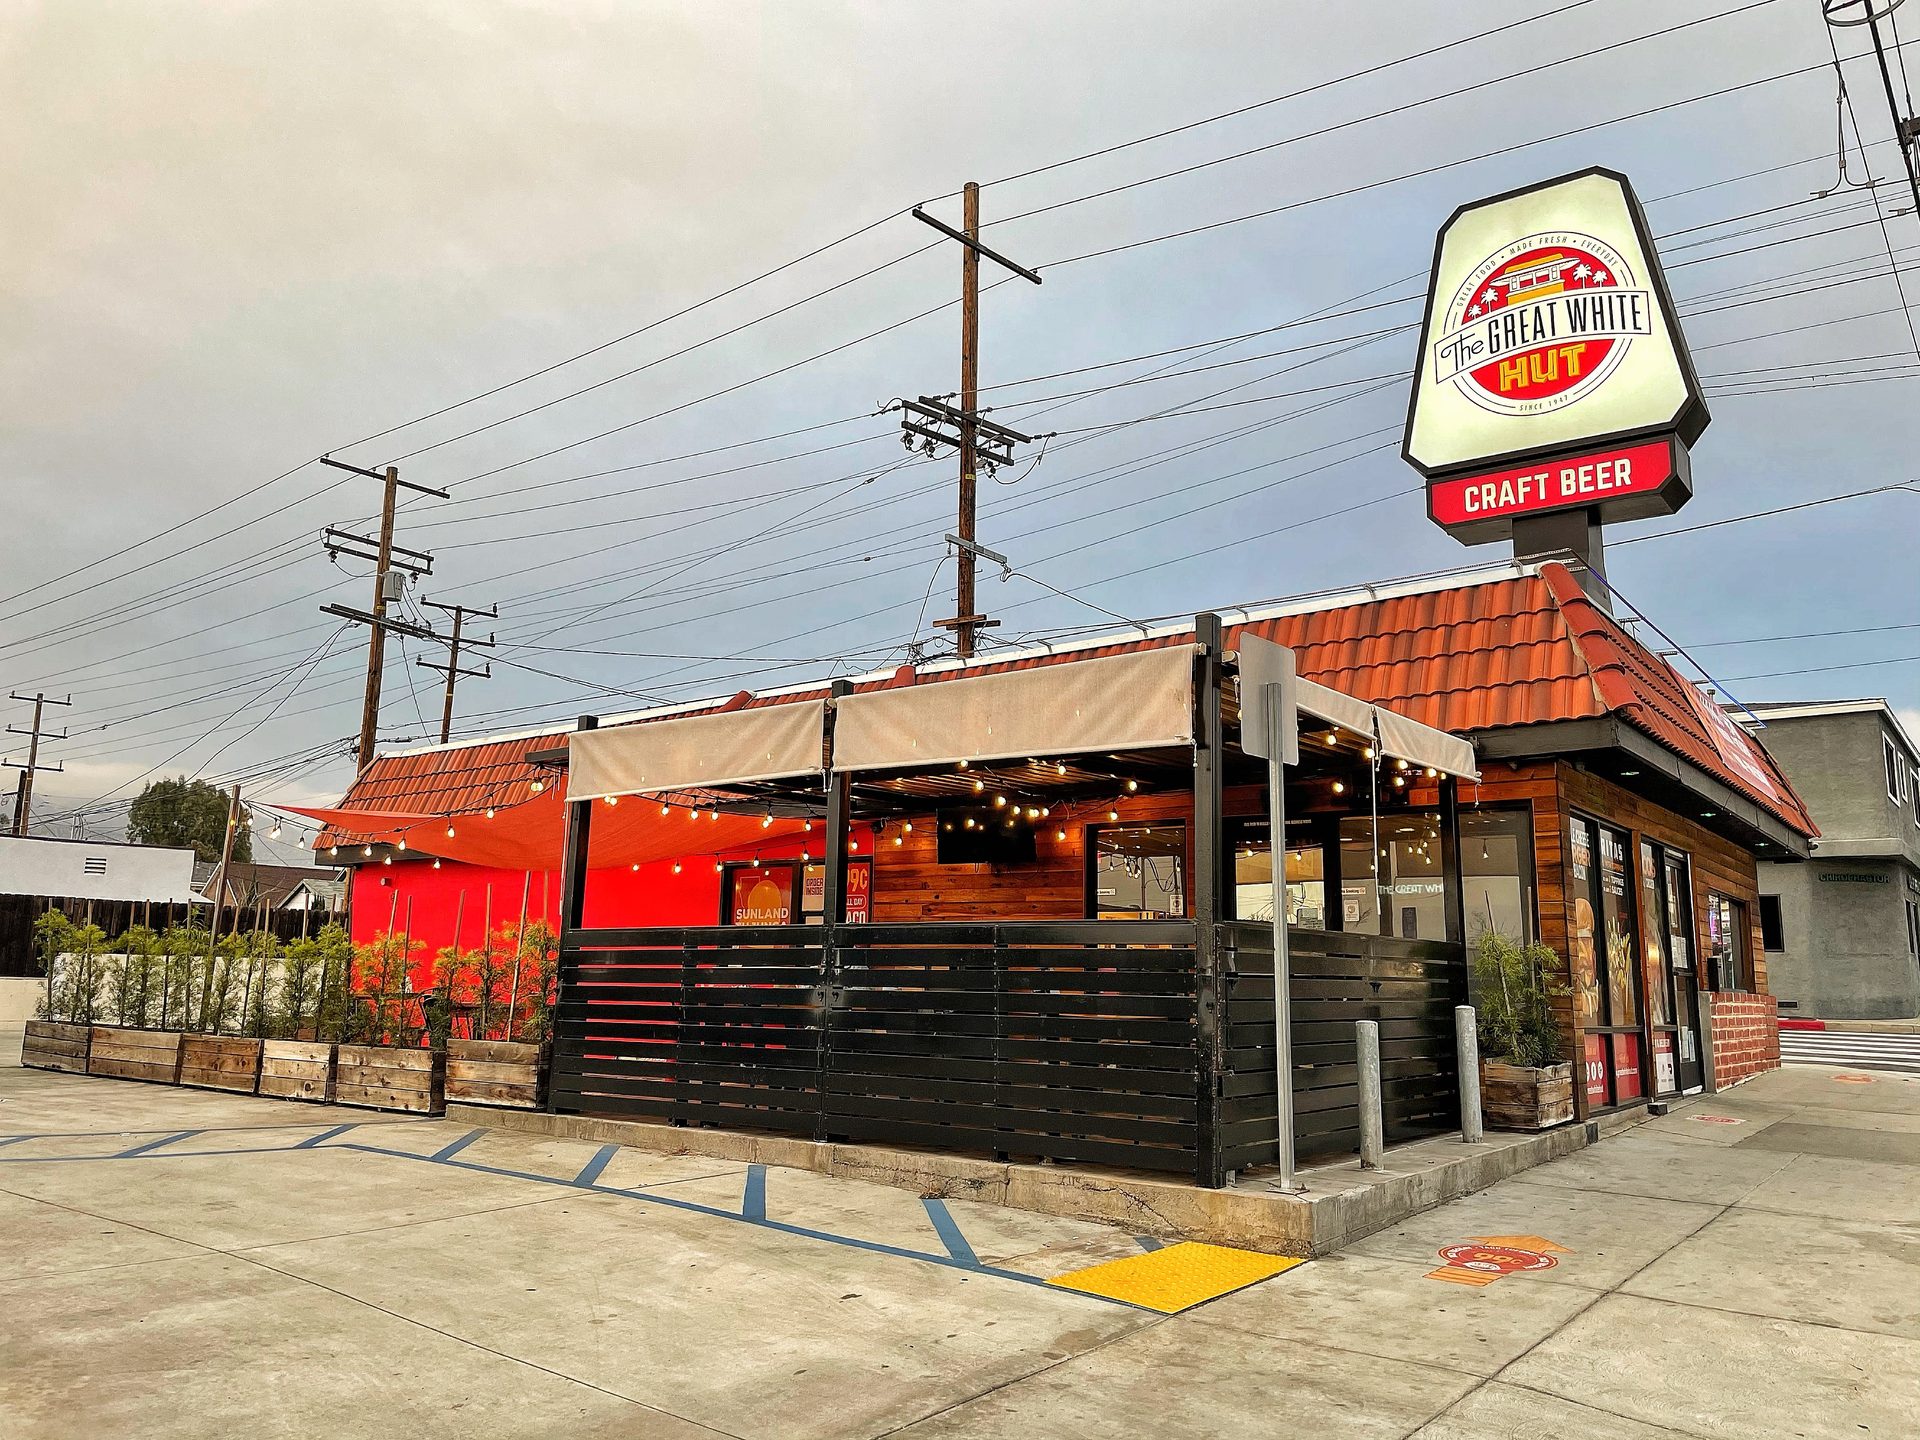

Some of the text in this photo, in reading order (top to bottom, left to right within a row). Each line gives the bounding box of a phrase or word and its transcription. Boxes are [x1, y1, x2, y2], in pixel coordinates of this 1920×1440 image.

[1457, 235, 1618, 307] GREAT FOOD MADE FRESH EVERYDAY
[1440, 294, 1642, 371] The GREAT WHITE
[1499, 343, 1587, 392] HUT
[1519, 403, 1543, 412] SINCE
[1464, 458, 1632, 513] CRAFT BEER
[805, 877, 824, 887] ORDER
[805, 887, 823, 896] INSIDE
[1394, 884, 1424, 894] GREAT
[736, 907, 789, 920] SUNLAND
